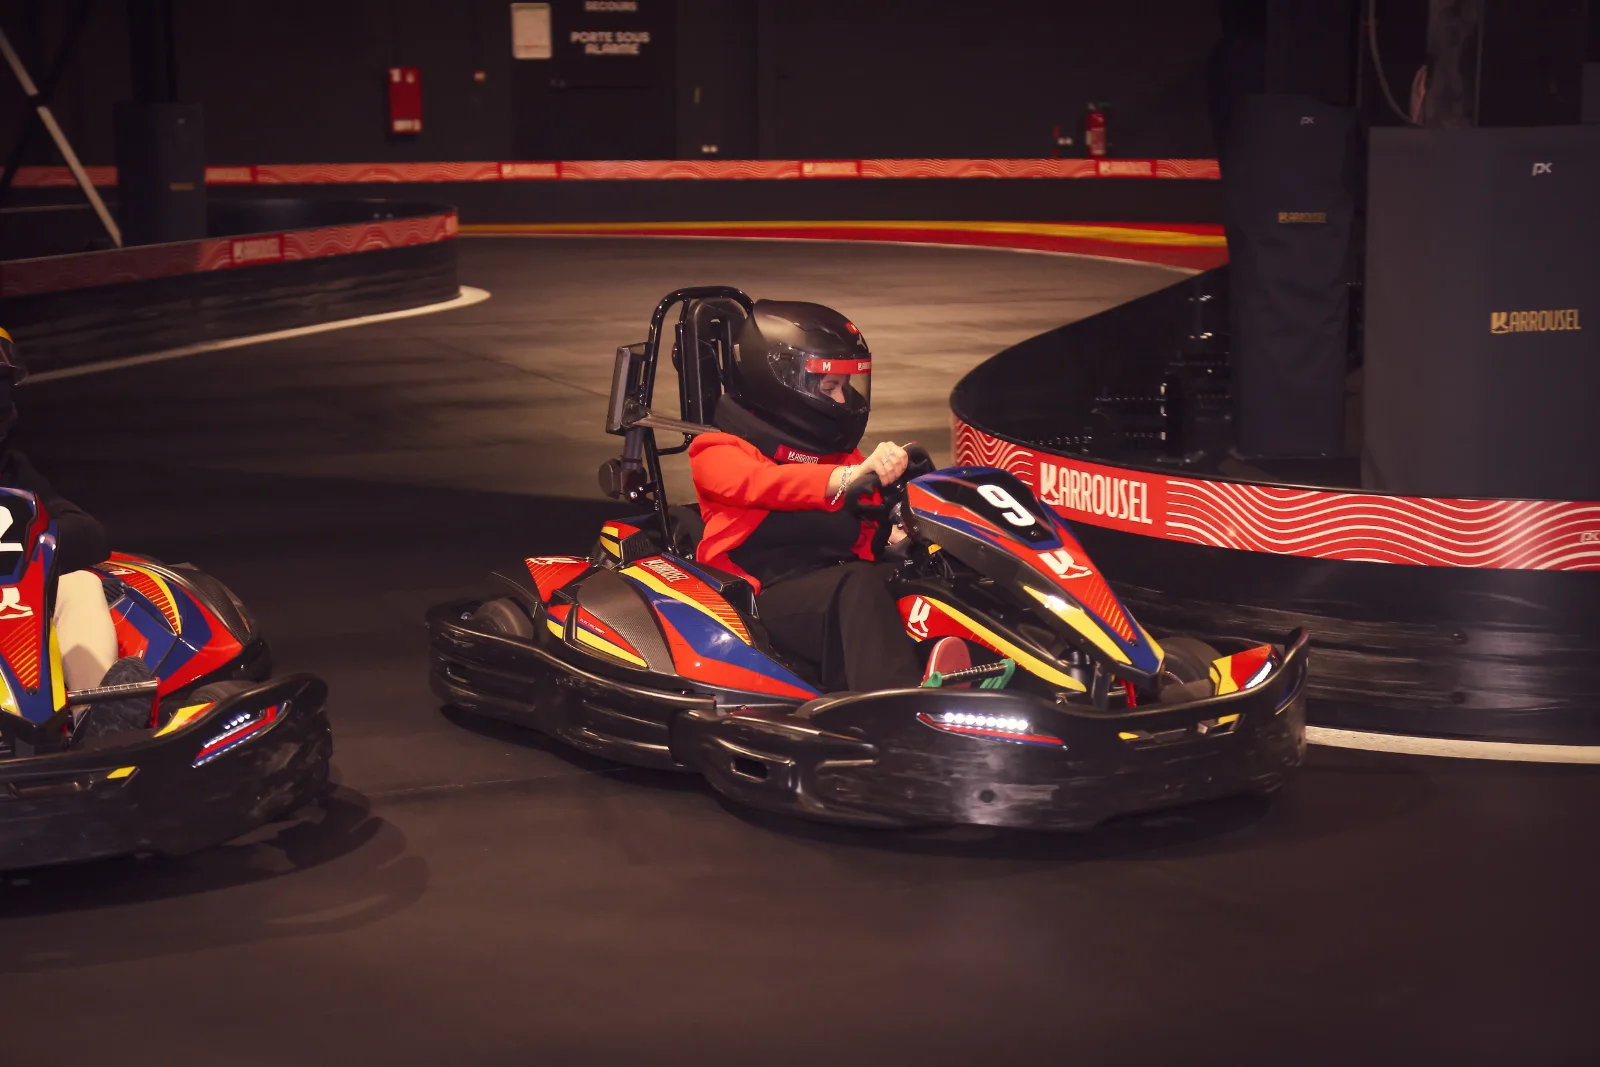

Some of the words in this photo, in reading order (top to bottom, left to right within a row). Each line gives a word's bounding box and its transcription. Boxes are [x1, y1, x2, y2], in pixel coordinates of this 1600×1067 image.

[570, 31, 613, 43] PORTE
[616, 31, 650, 43] SOUS
[1490, 309, 1582, 334] KARROUSEL
[822, 361, 831, 372] M
[976, 484, 1036, 527] 9
[1040, 462, 1153, 524] KARROUSEL
